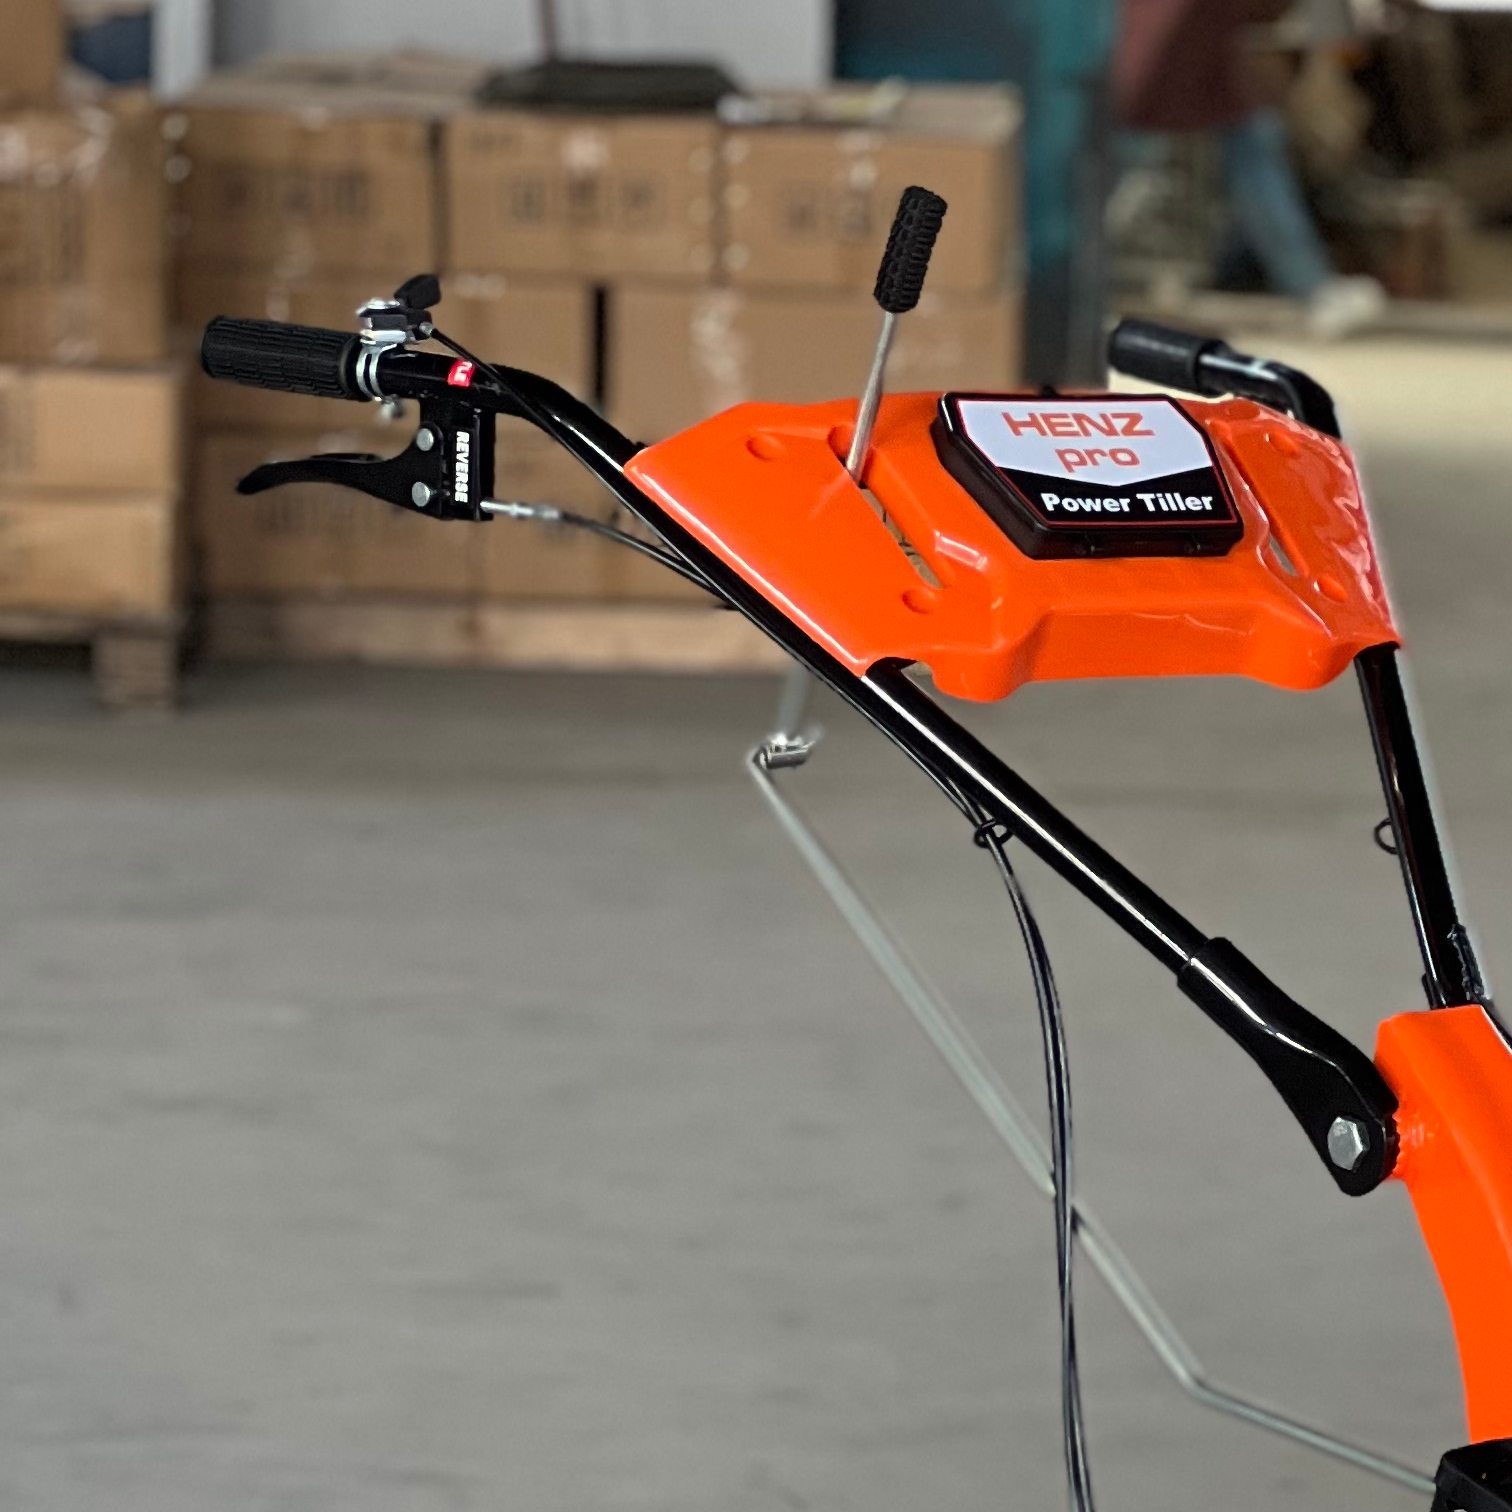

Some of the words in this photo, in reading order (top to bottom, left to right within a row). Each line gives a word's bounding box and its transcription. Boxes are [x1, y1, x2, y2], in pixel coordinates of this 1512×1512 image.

[1002, 412, 1156, 438] HENZ
[455, 431, 470, 503] REVERSE
[1055, 447, 1141, 474] pro
[1040, 492, 1131, 513] Power
[1136, 492, 1214, 512] Tiller
